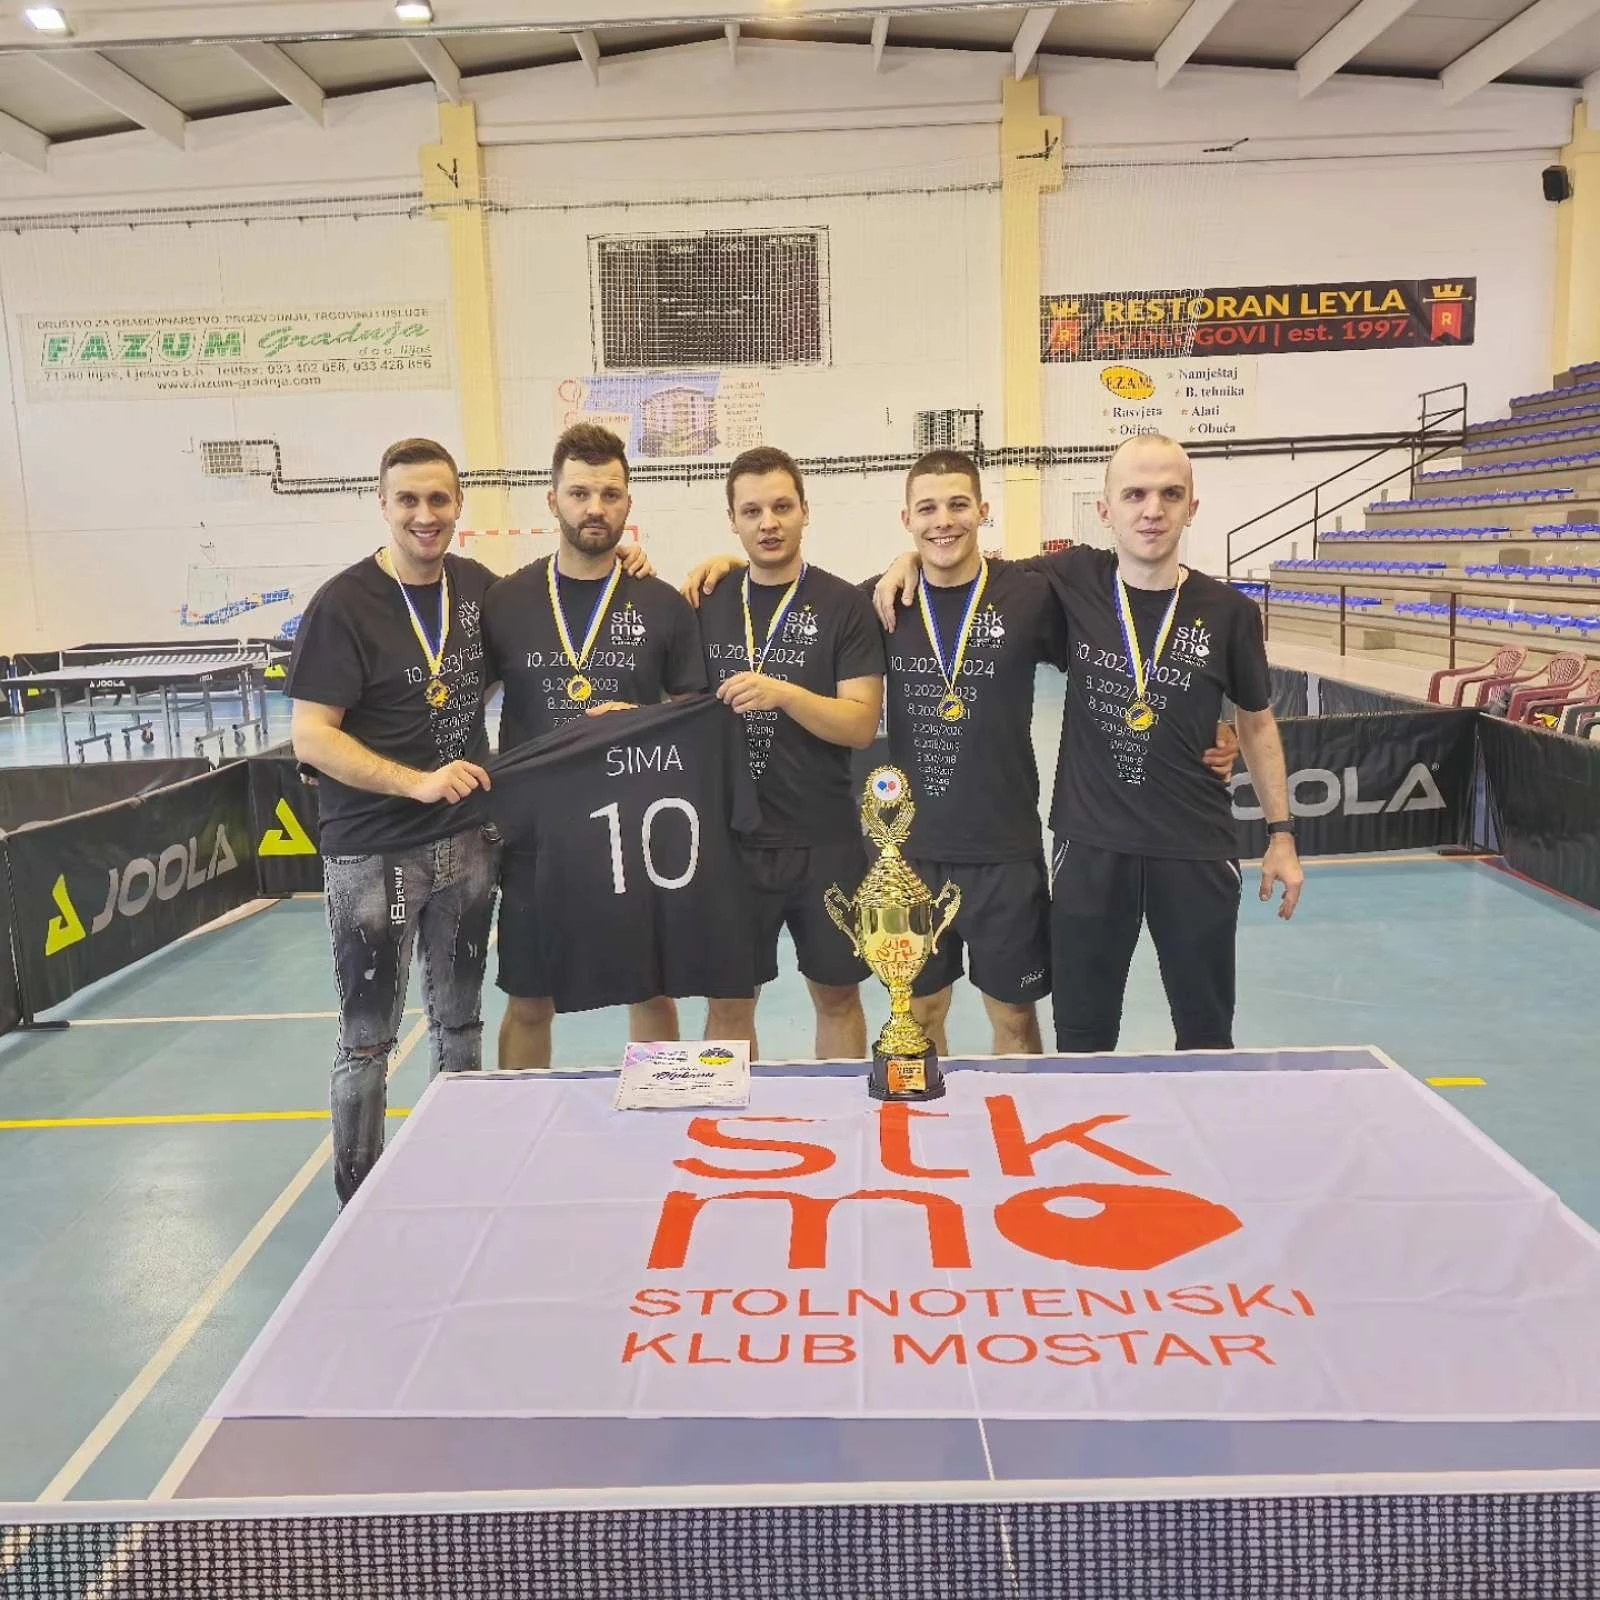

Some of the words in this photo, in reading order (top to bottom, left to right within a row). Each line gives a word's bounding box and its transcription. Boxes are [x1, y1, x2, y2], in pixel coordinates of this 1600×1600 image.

[1103, 291, 1290, 324] RESTORAN
[1301, 288, 1406, 315] LEYLA
[1440, 311, 1452, 324] R
[1287, 325, 1334, 343] est.
[1342, 319, 1414, 341] 1997.
[45, 331, 242, 363] FAZUM
[1186, 386, 1199, 398] B.
[1201, 386, 1245, 397] tehnika
[1191, 406, 1220, 417] Alati
[611, 609, 644, 625] stk
[786, 611, 819, 626] stk
[972, 610, 1004, 627] stk
[1176, 626, 1212, 647] stk
[96, 680, 126, 688] JOOLA
[1229, 762, 1447, 821] OOLA
[590, 797, 700, 894] 10
[92, 823, 239, 933] JOOLA
[673, 1094, 1172, 1179] stk
[629, 1283, 1316, 1317] STOLNOTENISKI
[621, 1332, 860, 1365] KLUB
[893, 1329, 1277, 1367] MOSTAR
